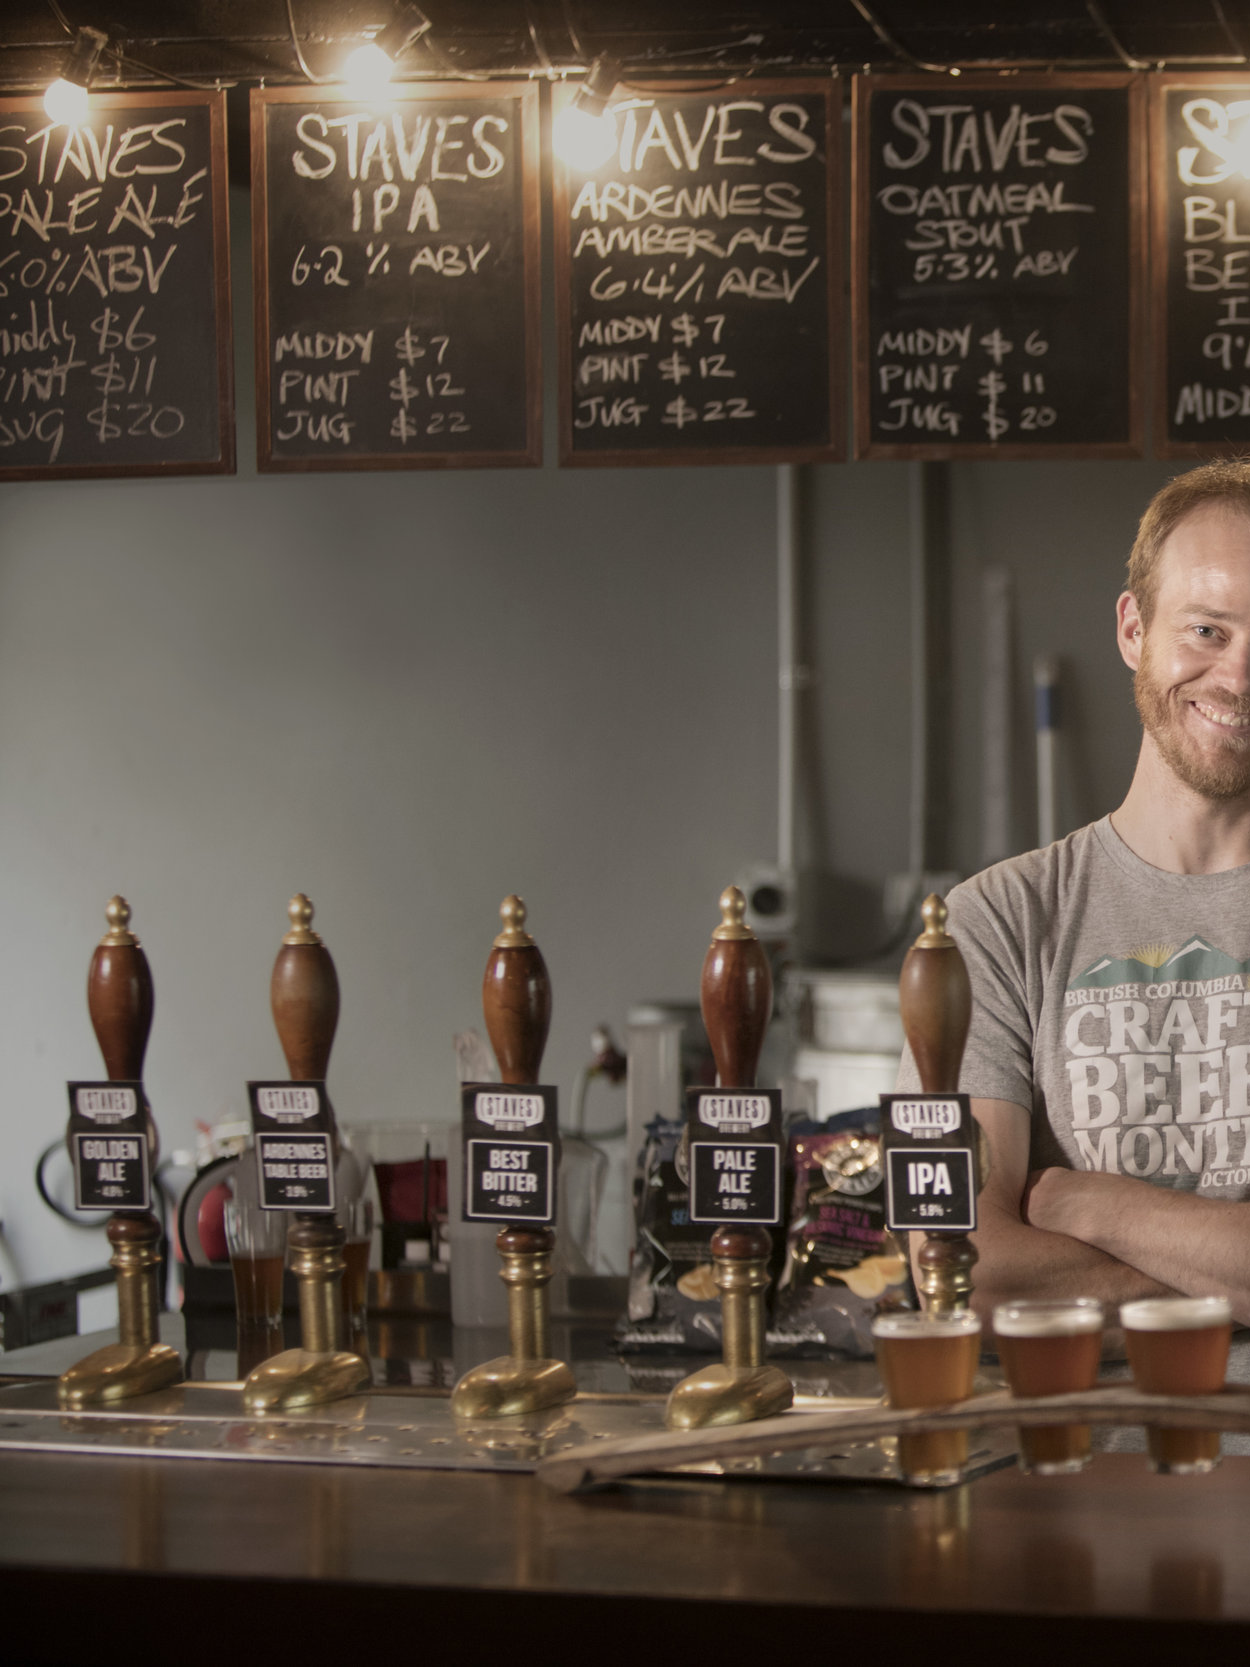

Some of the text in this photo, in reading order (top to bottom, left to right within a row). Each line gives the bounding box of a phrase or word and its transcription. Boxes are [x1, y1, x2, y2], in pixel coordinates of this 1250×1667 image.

[292, 113, 509, 182] STAVES
[592, 98, 817, 173] TAVES
[882, 99, 1095, 174] STAVES
[107, 167, 207, 239] ALE
[352, 183, 440, 233] IPA
[571, 180, 804, 222] ARDENNES
[876, 181, 1096, 218] OATMEAL
[573, 224, 810, 258] AMBER ALE
[905, 216, 1031, 254] STOUT
[409, 241, 490, 276] ABV
[1013, 246, 1080, 280] ABV
[716, 256, 820, 304] ABV
[90, 305, 156, 354] $6
[275, 329, 374, 364] MIDDY
[578, 313, 662, 348] MIDDY
[877, 323, 973, 359] MIDDY
[90, 352, 157, 395] $11
[580, 353, 649, 385] PINT
[879, 364, 960, 394] PINT
[279, 369, 360, 407] PINT
[87, 398, 184, 443] $20
[277, 410, 356, 445] JUG
[574, 396, 649, 429] JUG
[878, 398, 962, 437] JUG
[1064, 974, 1244, 1008] BRITISH COLUMBIA
[82, 1140, 139, 1160] GOLDEN
[489, 1149, 531, 1170] BEST
[713, 1150, 757, 1171] PALE
[97, 1162, 126, 1181] ALE
[482, 1171, 538, 1193] BITTER
[718, 1173, 752, 1194] ALE
[908, 1162, 953, 1196] IPA
